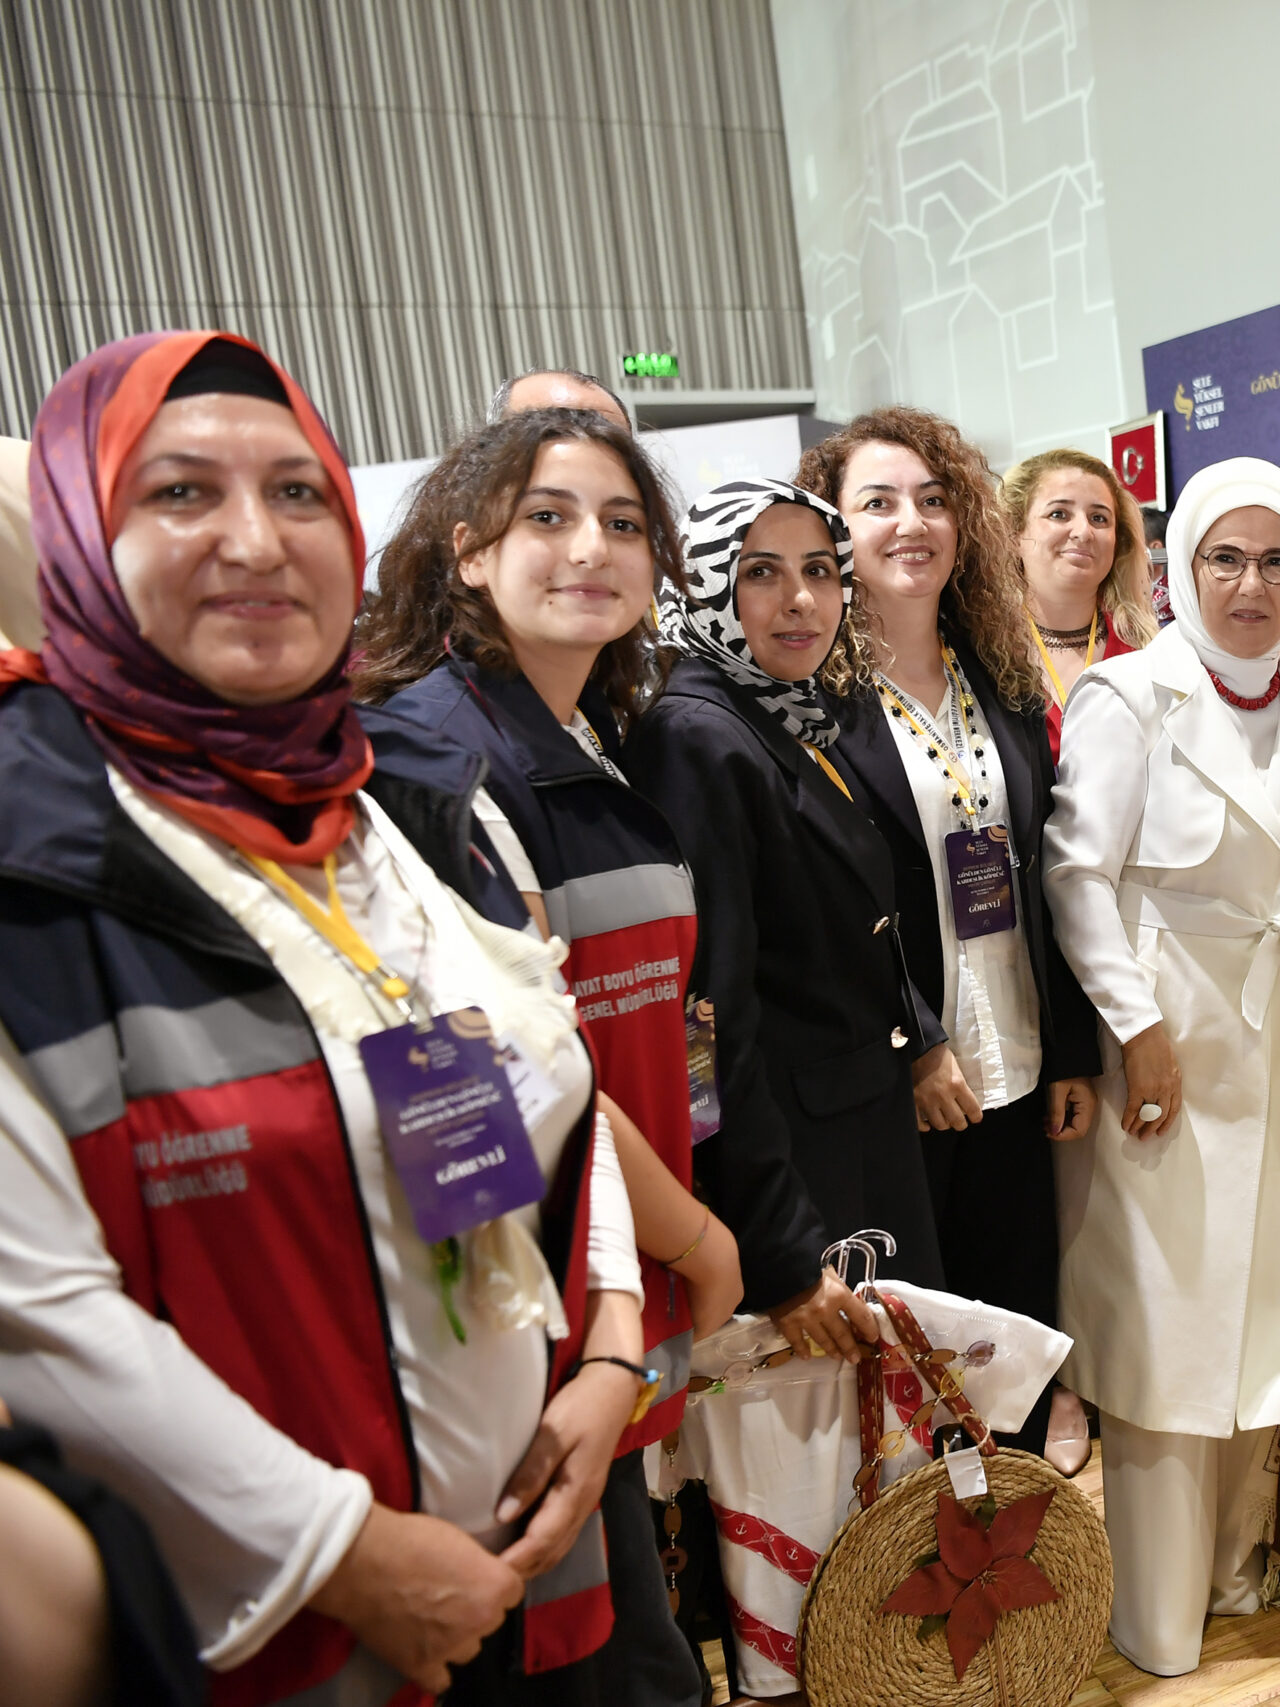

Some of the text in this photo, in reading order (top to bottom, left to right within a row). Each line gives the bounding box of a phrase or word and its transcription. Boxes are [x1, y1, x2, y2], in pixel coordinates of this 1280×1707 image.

[968, 898, 1000, 914] GÖREVLİ
[604, 968, 634, 991] BOYU
[634, 956, 680, 984] ÖĞRENME
[579, 1002, 616, 1022] GENEL
